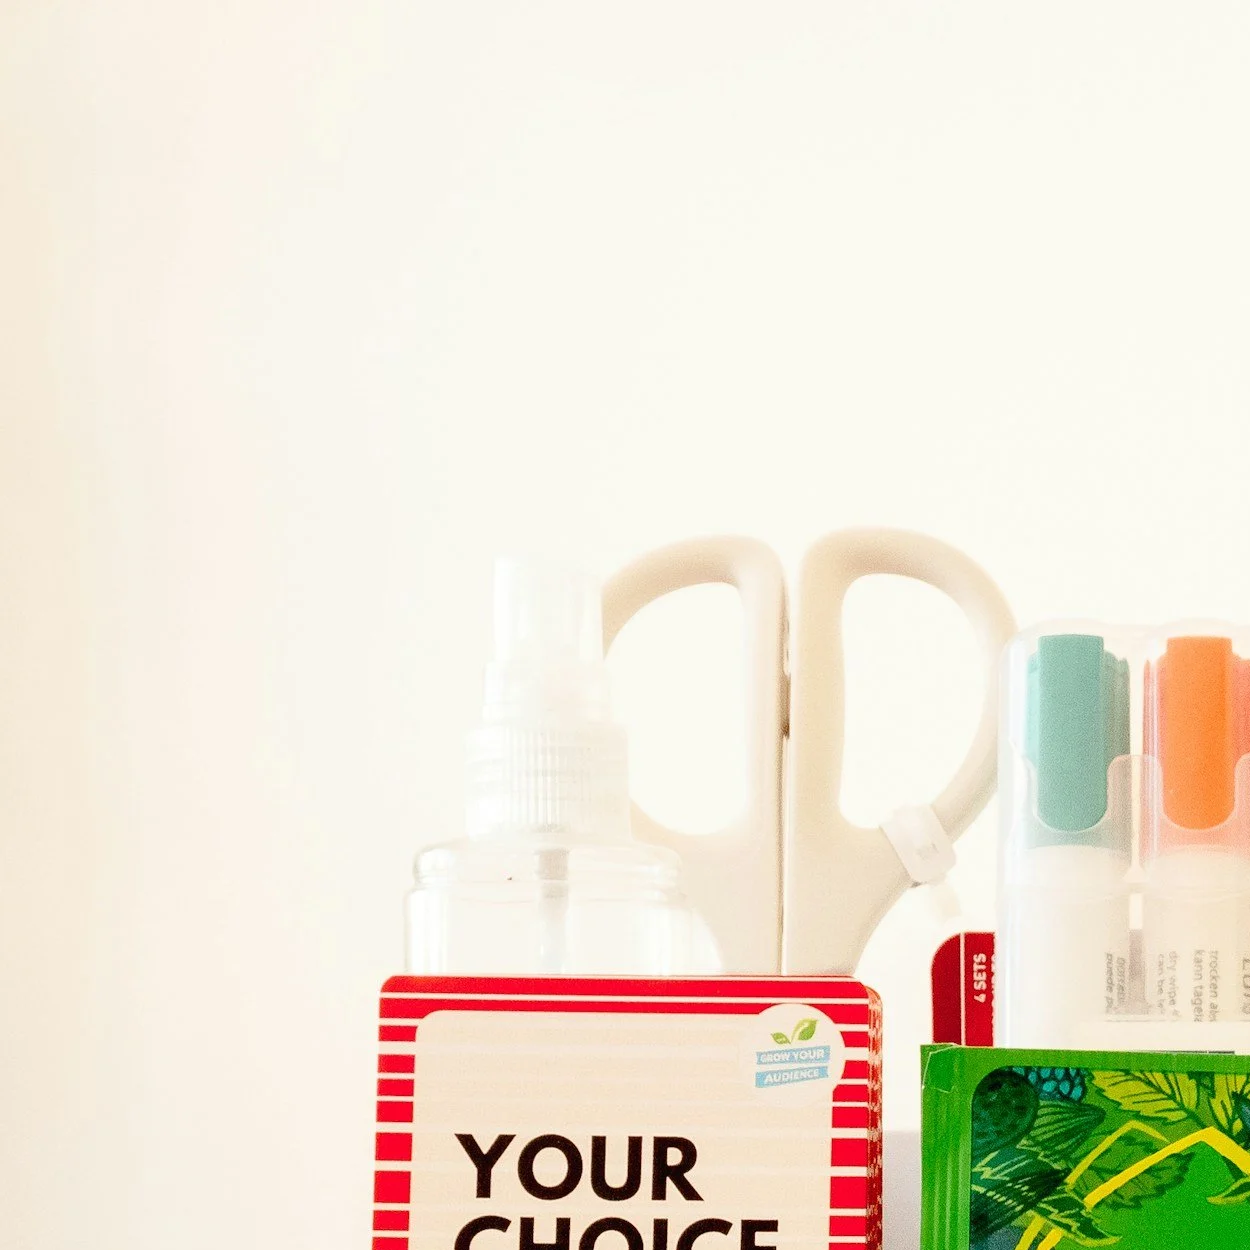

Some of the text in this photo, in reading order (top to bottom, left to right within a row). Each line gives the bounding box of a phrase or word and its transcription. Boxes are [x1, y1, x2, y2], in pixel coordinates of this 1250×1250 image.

[973, 953, 987, 991] SETS
[1193, 949, 1205, 981] kann
[1208, 950, 1219, 998] trocken
[760, 1048, 825, 1063] GROW YOUR
[763, 1067, 820, 1085] AUDIENCE
[454, 1134, 704, 1201] YOUR
